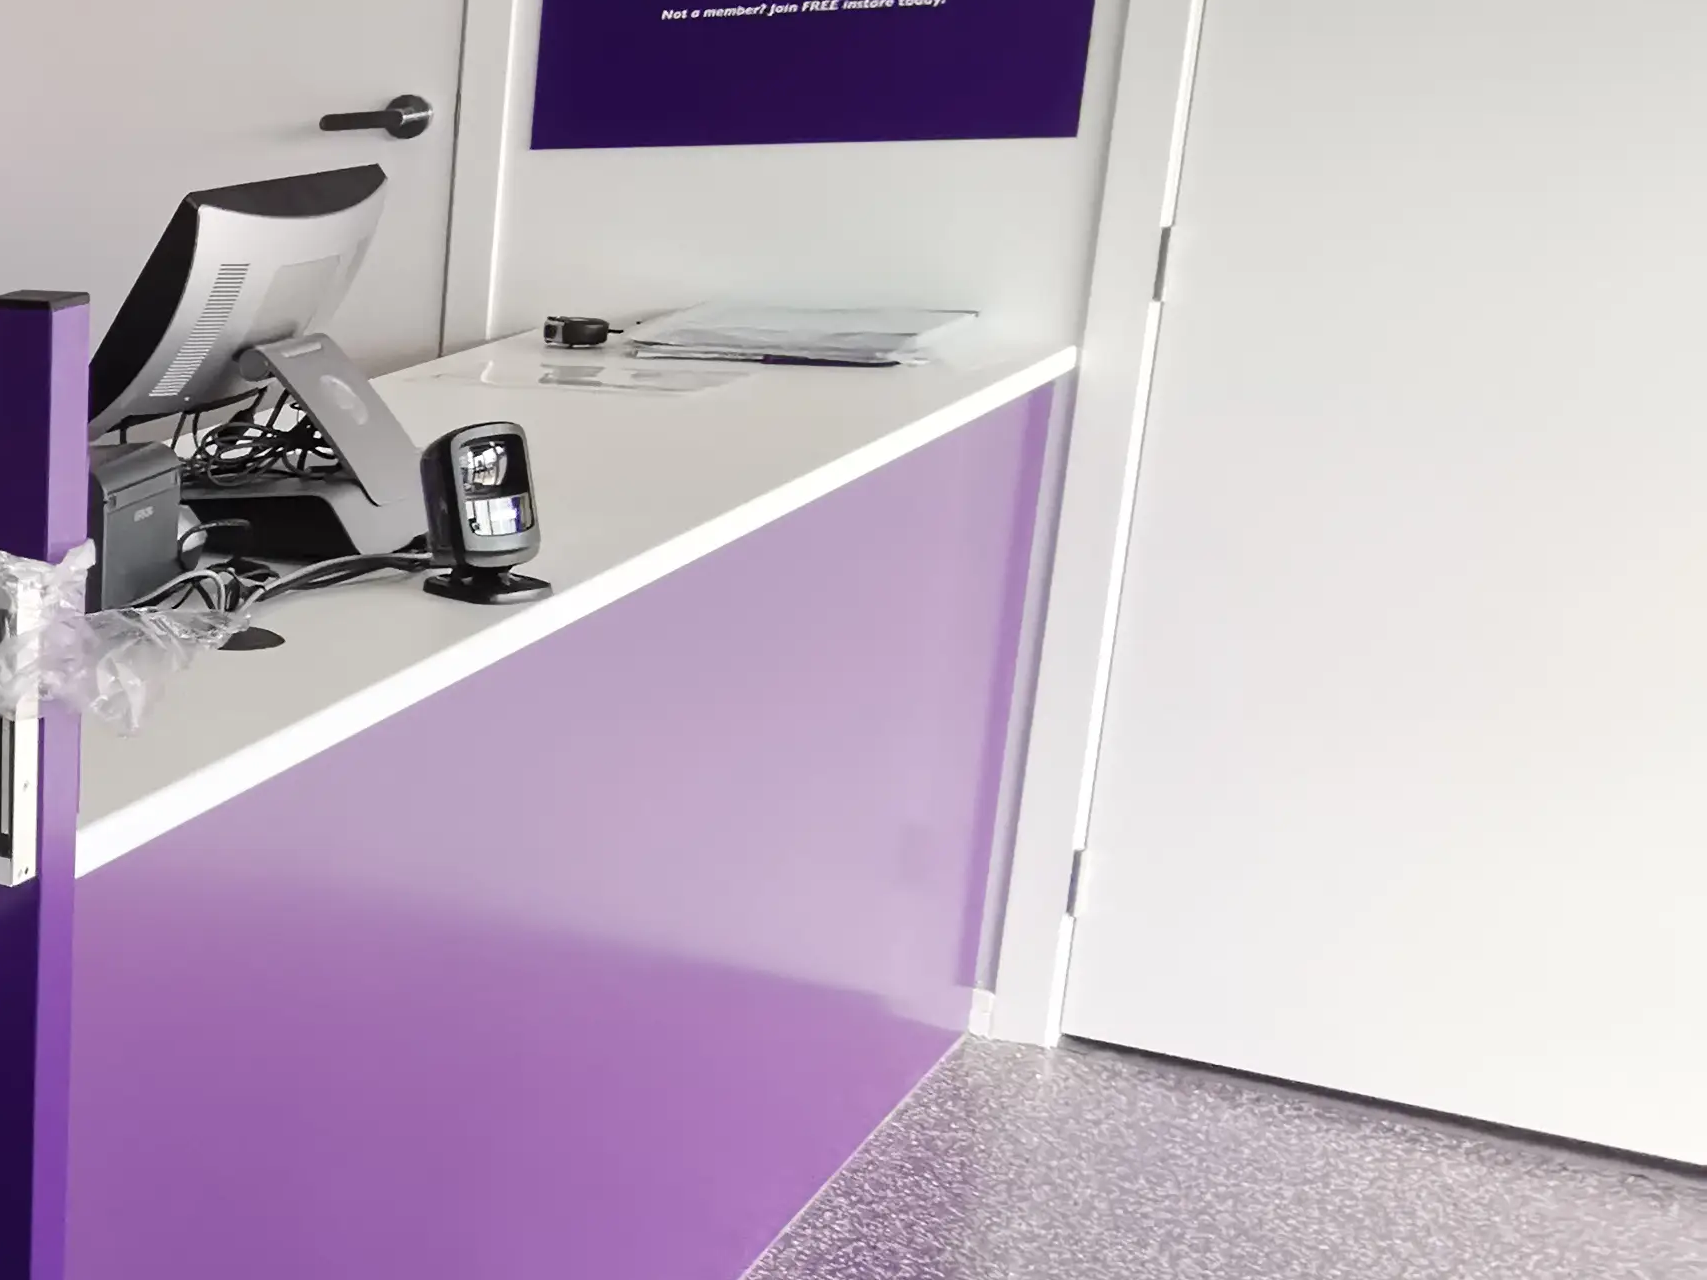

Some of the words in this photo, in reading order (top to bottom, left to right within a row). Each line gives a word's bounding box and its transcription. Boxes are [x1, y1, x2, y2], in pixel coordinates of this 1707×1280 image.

[661, 9, 687, 20] Not
[691, 10, 700, 18] a
[703, 3, 766, 18] member?
[801, 0, 840, 12] FREE
